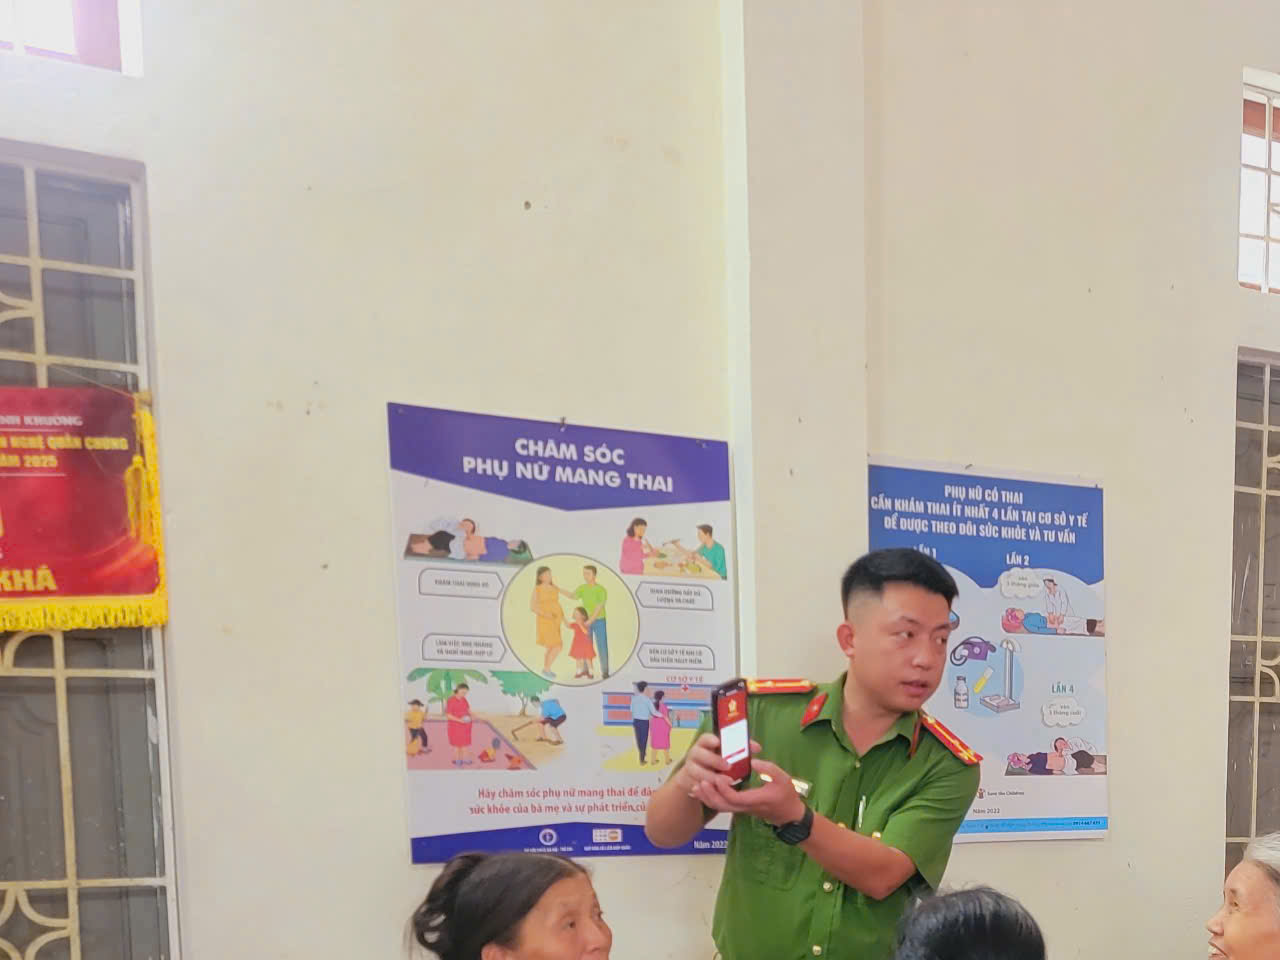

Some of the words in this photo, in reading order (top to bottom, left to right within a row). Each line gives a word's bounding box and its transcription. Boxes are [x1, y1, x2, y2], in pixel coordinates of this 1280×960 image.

[0, 415, 20, 425] NH
[515, 438, 578, 460] CHĂM
[583, 443, 625, 466] SÓC
[0, 453, 20, 468] ĂM
[462, 456, 508, 481] PHỤ
[515, 461, 551, 481] NỮ
[555, 466, 621, 488] MANG
[626, 472, 673, 493] THAI
[944, 484, 966, 502] PHỤ
[968, 485, 983, 500] NỮ
[984, 486, 999, 502] CÓ
[1001, 490, 1023, 505] THAI
[894, 496, 925, 513] KHÁM
[927, 501, 950, 517] THAI
[952, 501, 962, 517] ÍT
[964, 503, 990, 519] NHẤT
[992, 507, 999, 520] 4
[1021, 510, 1036, 526] TẠI
[1038, 511, 1052, 524] CƠ
[1054, 510, 1067, 526] SỞ
[1068, 514, 1075, 527] Y
[1077, 511, 1089, 528] TẾ
[884, 512, 899, 530] ĐỂ
[900, 516, 929, 535] ĐƯỢC
[930, 519, 957, 535] THEO
[979, 521, 999, 538] SỨC
[1028, 525, 1041, 542] VÀ
[1057, 528, 1076, 545] VẤN
[1023, 555, 1030, 566] 2
[0, 564, 59, 592] KHÁ
[1068, 684, 1074, 694] 4
[498, 788, 523, 798] chăm
[525, 787, 540, 798] sóc
[542, 788, 561, 800] phụ
[563, 787, 576, 798] nữ
[578, 789, 604, 800] mang
[607, 787, 625, 797] thai
[627, 786, 639, 797] để
[469, 804, 485, 815] sức
[512, 802, 529, 813] của
[531, 802, 542, 813] bà
[544, 804, 560, 815] mẹ
[562, 802, 573, 812] và
[574, 803, 585, 814] sự
[587, 802, 610, 814] phát
[634, 801, 647, 812] củ
[693, 840, 710, 849] Năm
